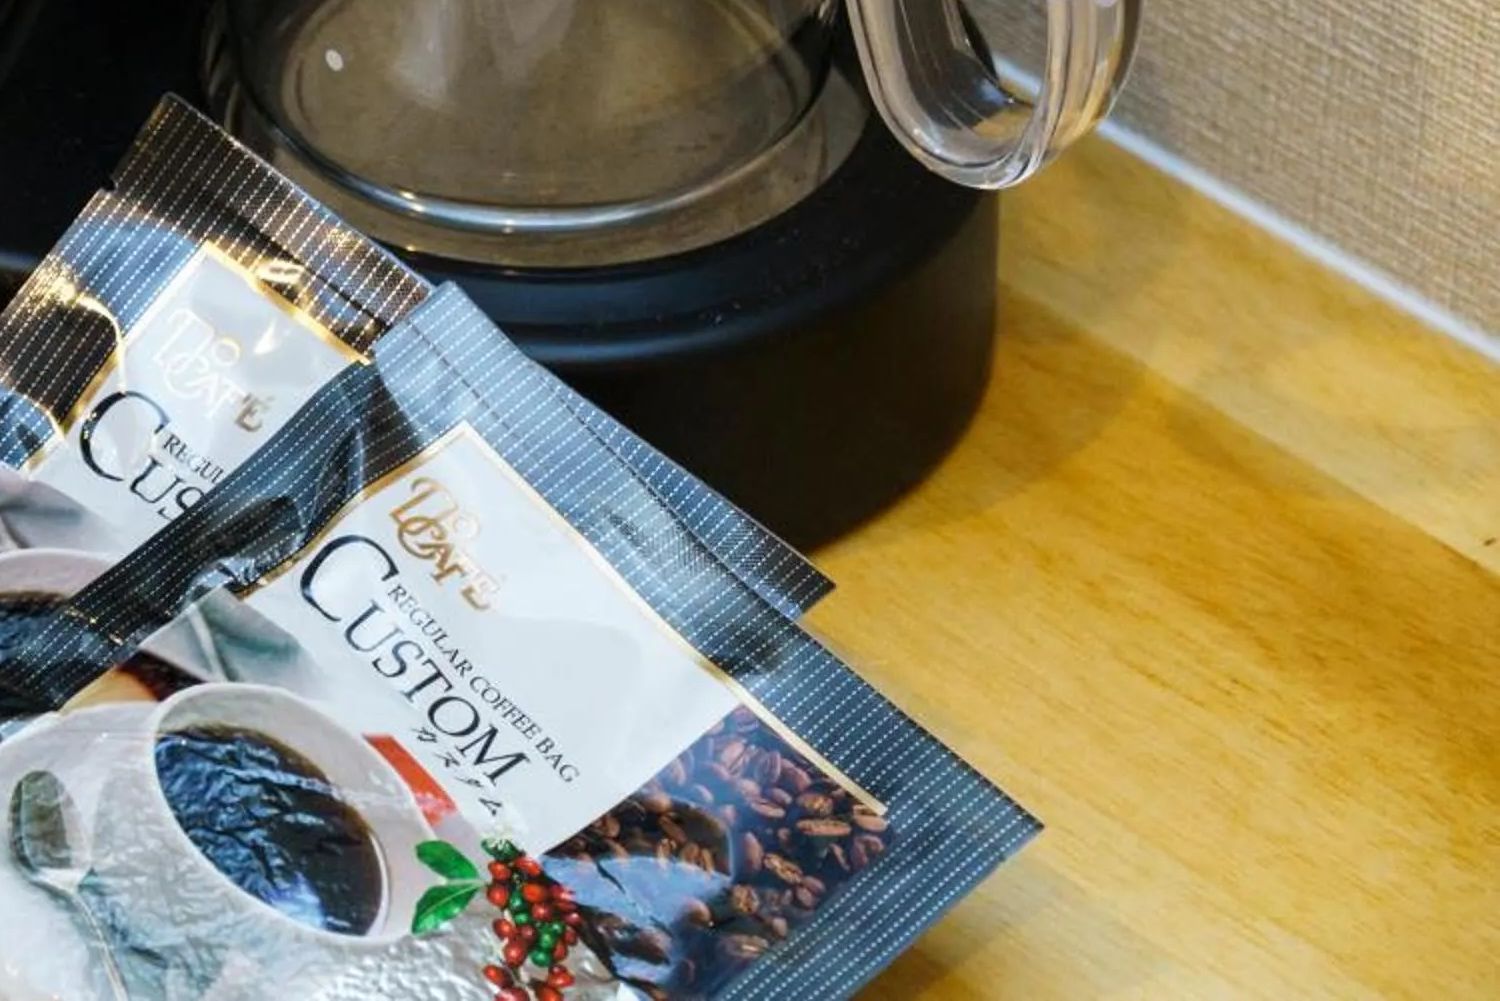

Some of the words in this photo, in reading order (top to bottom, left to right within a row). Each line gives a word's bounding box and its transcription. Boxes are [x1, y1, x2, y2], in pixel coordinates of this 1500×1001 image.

[301, 534, 531, 787] CUSTOM
[387, 584, 473, 677] REGULAR
[469, 675, 540, 741] COFFEE
[534, 736, 581, 784] BAG
